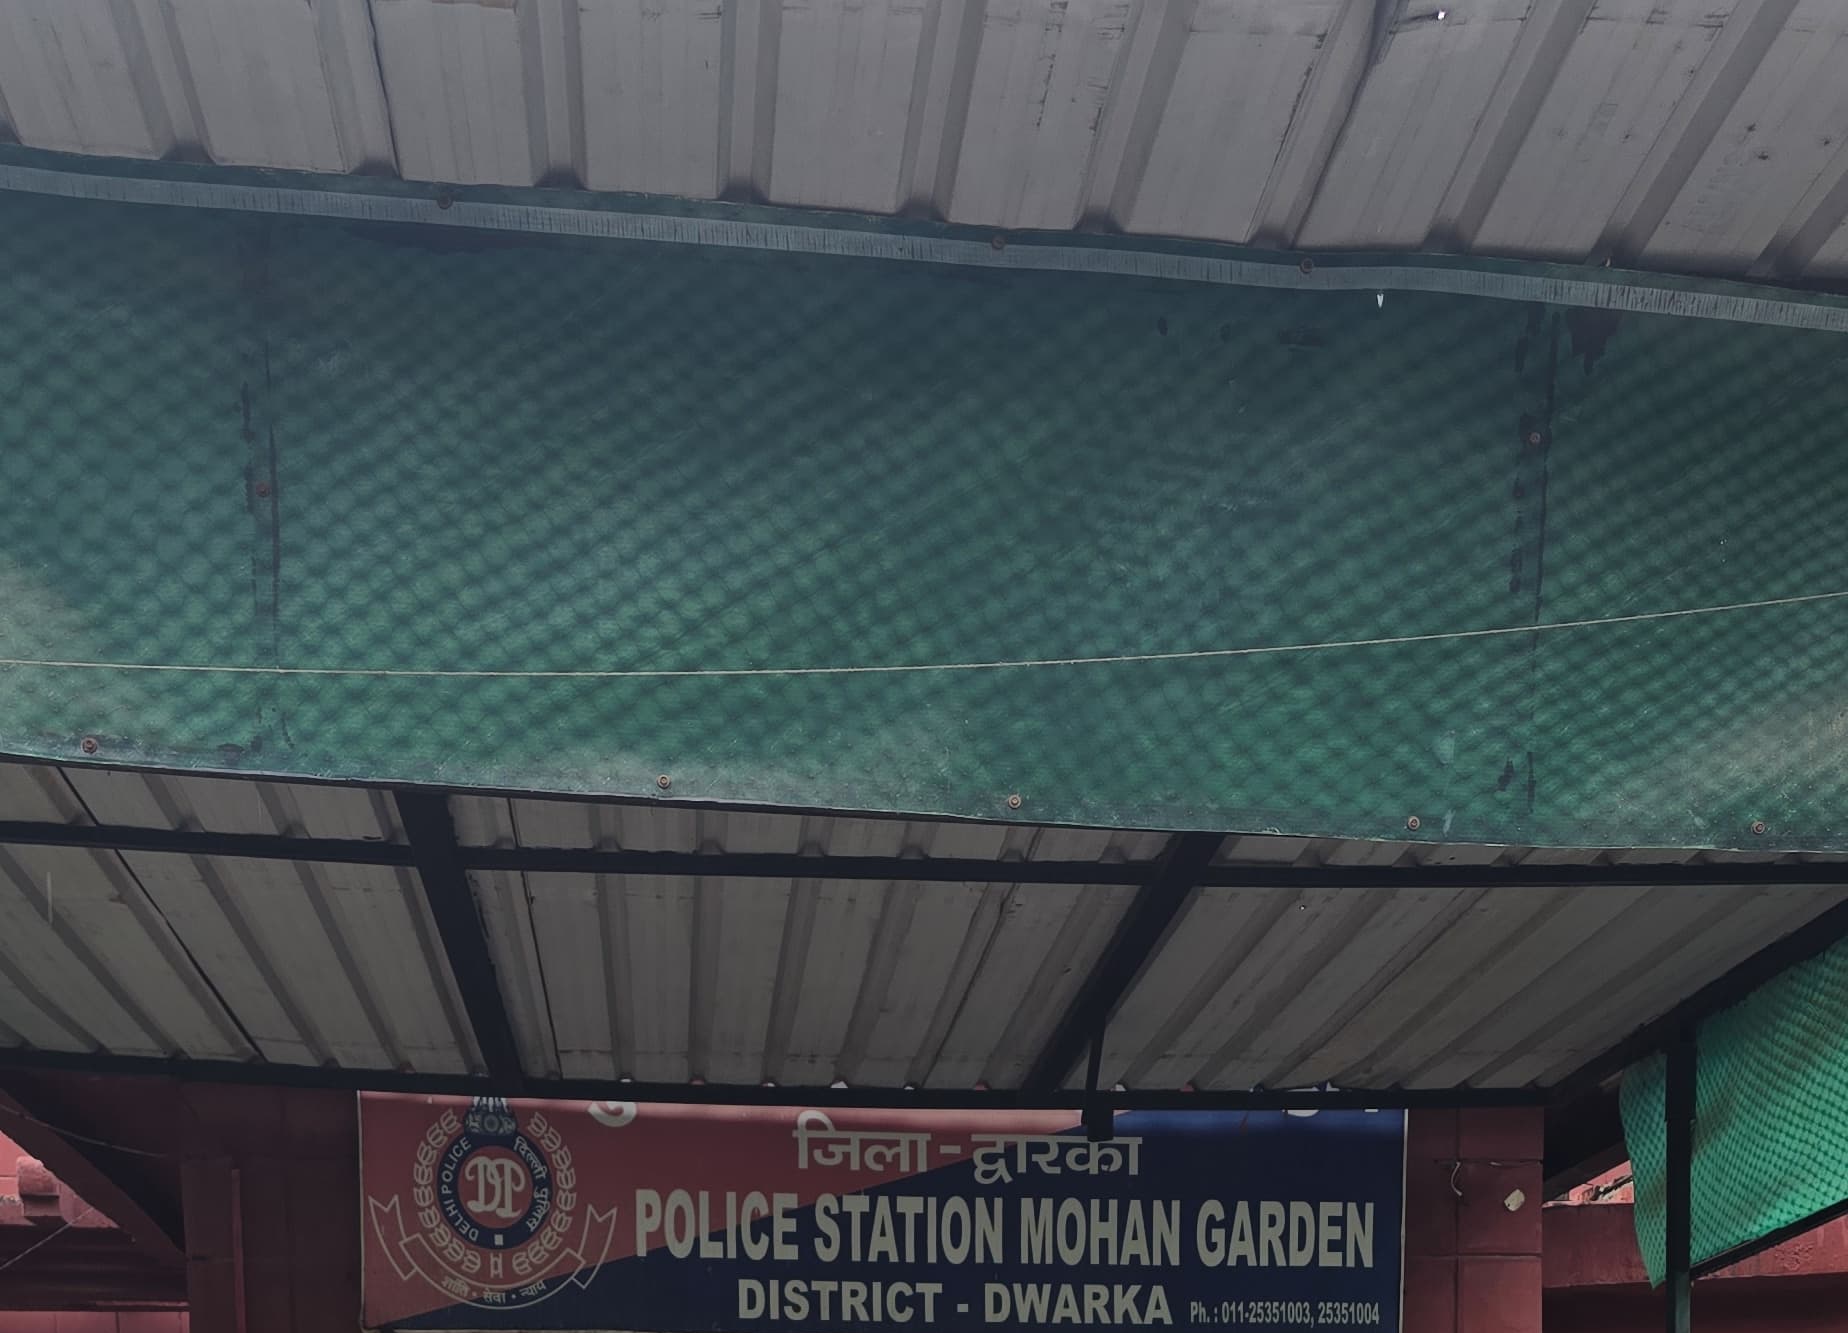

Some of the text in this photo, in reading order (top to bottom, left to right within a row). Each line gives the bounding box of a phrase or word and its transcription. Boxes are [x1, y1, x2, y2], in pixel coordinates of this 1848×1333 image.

[793, 1110, 931, 1171] जिला
[971, 1133, 1143, 1185] द्वारका
[441, 1137, 479, 1242] DELHI POLICE
[635, 1188, 1376, 1269] POLICE STATION MOHAN GARDEN
[738, 1279, 943, 1324] DISTRICT
[984, 1282, 1174, 1326] DWARKA
[1221, 1300, 1315, 1328] 011-25351003,
[1317, 1301, 1380, 1325] 25351004
